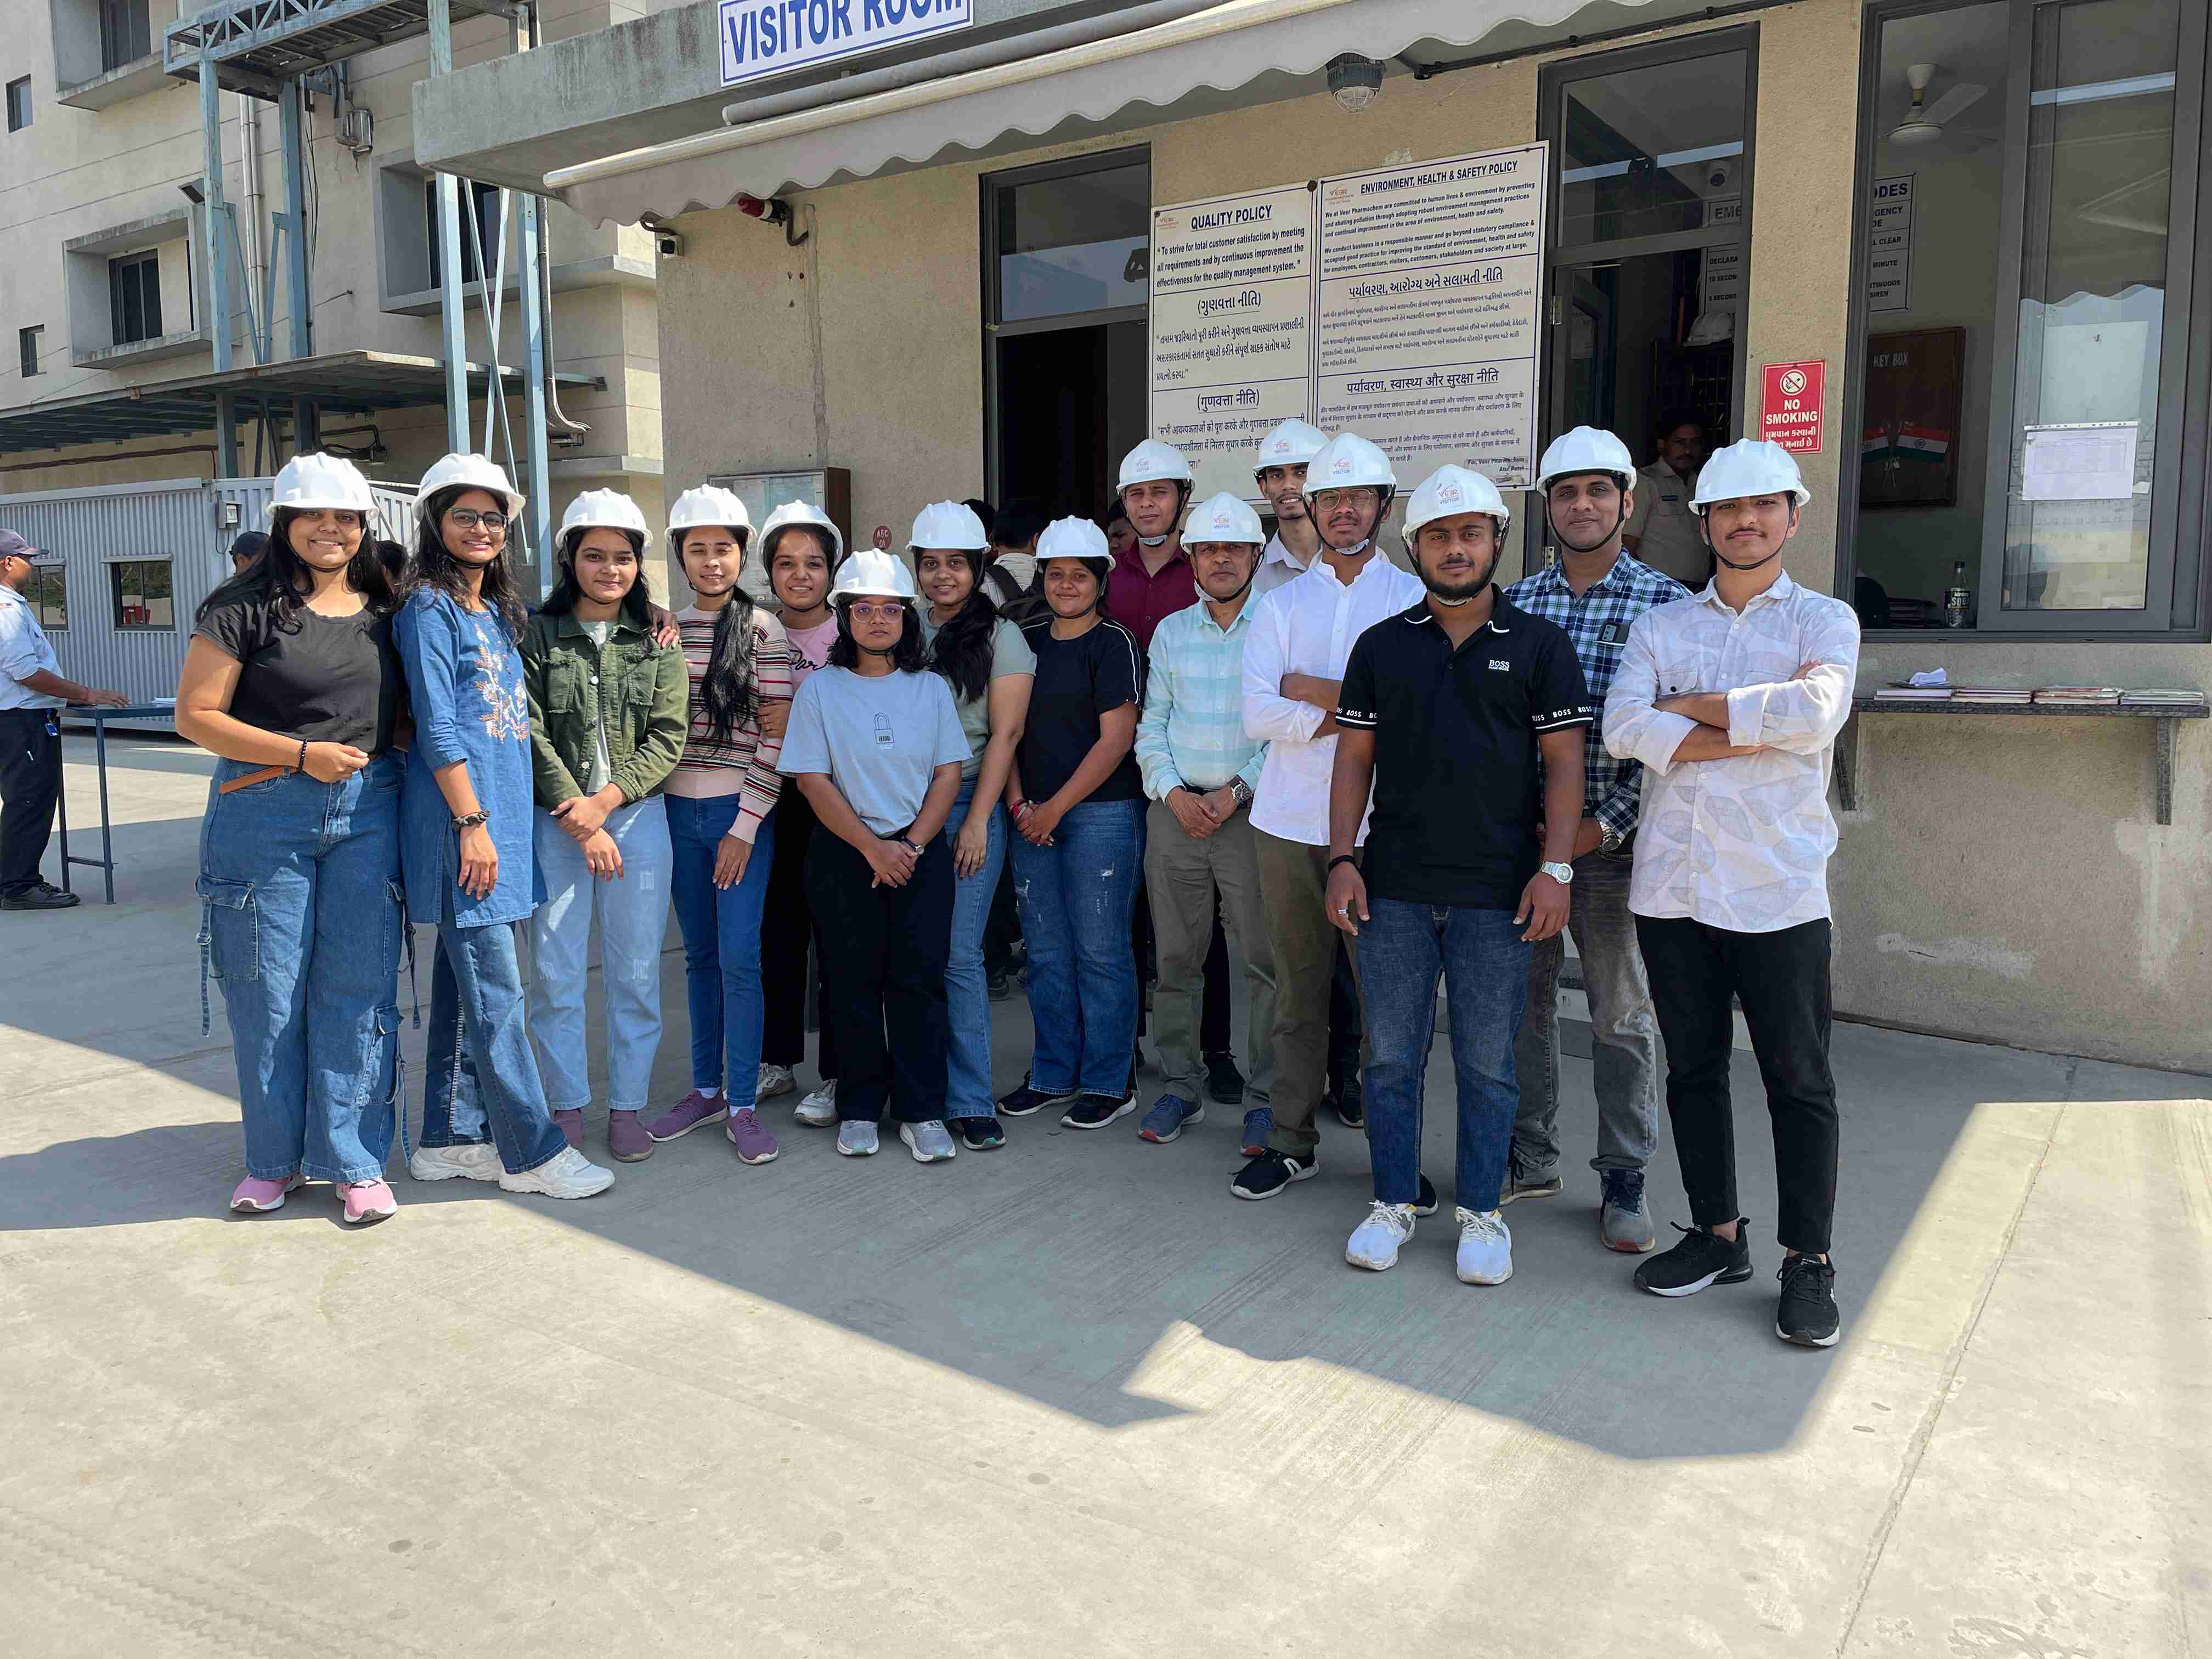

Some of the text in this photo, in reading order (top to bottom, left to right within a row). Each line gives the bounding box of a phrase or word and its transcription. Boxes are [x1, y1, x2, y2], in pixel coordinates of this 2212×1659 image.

[728, 0, 853, 65] VISITOR
[1361, 160, 1518, 194] ENVIRONMENT, HEALTH & SAFETY POLICY
[1874, 183, 1908, 198] DES
[1191, 211, 1233, 230] QUALITY
[1235, 205, 1272, 223] POLICY
[1161, 227, 1305, 255] To strive for total customer satisfaction by meeting
[1879, 236, 1901, 245] CLEAR
[1165, 258, 1201, 272] requirements
[1202, 255, 1212, 266] and
[1214, 255, 1221, 266] by
[1222, 252, 1253, 263] continuous
[1255, 244, 1293, 259] improvement
[1294, 242, 1304, 253] the
[1156, 262, 1296, 287] effectiveness for the quality management system.
[1874, 352, 1909, 367] KEY BOX
[1784, 399, 1800, 411] NO
[1765, 411, 1818, 425] SMOKING
[1488, 659, 1510, 668] BOSS
[1346, 709, 1362, 718] BOSS
[1552, 709, 1571, 718] BOSS
